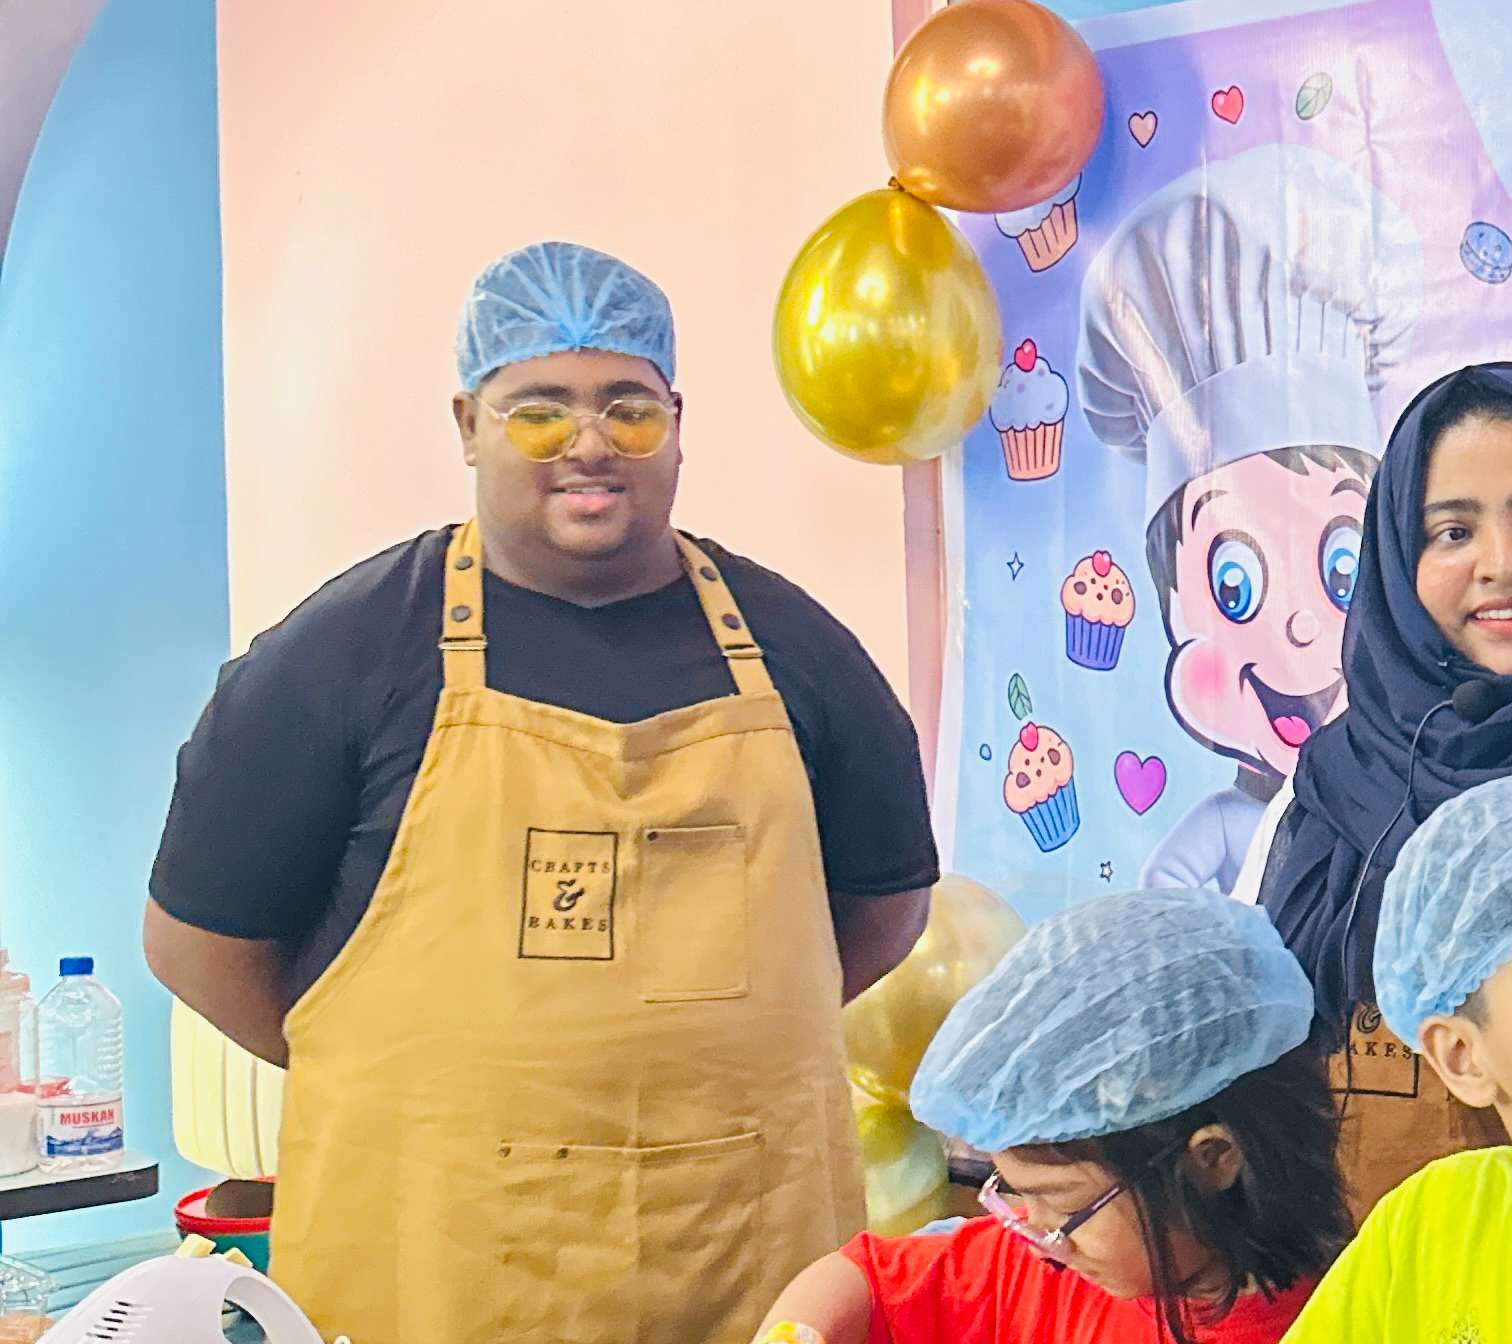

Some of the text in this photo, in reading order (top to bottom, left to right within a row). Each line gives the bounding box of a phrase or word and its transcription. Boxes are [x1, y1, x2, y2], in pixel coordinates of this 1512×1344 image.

[530, 859, 611, 873] CRAFTS
[552, 878, 586, 912] &
[528, 916, 608, 932] BAKES
[1348, 1040, 1413, 1060] AKES
[60, 1108, 115, 1126] MUSKAN
